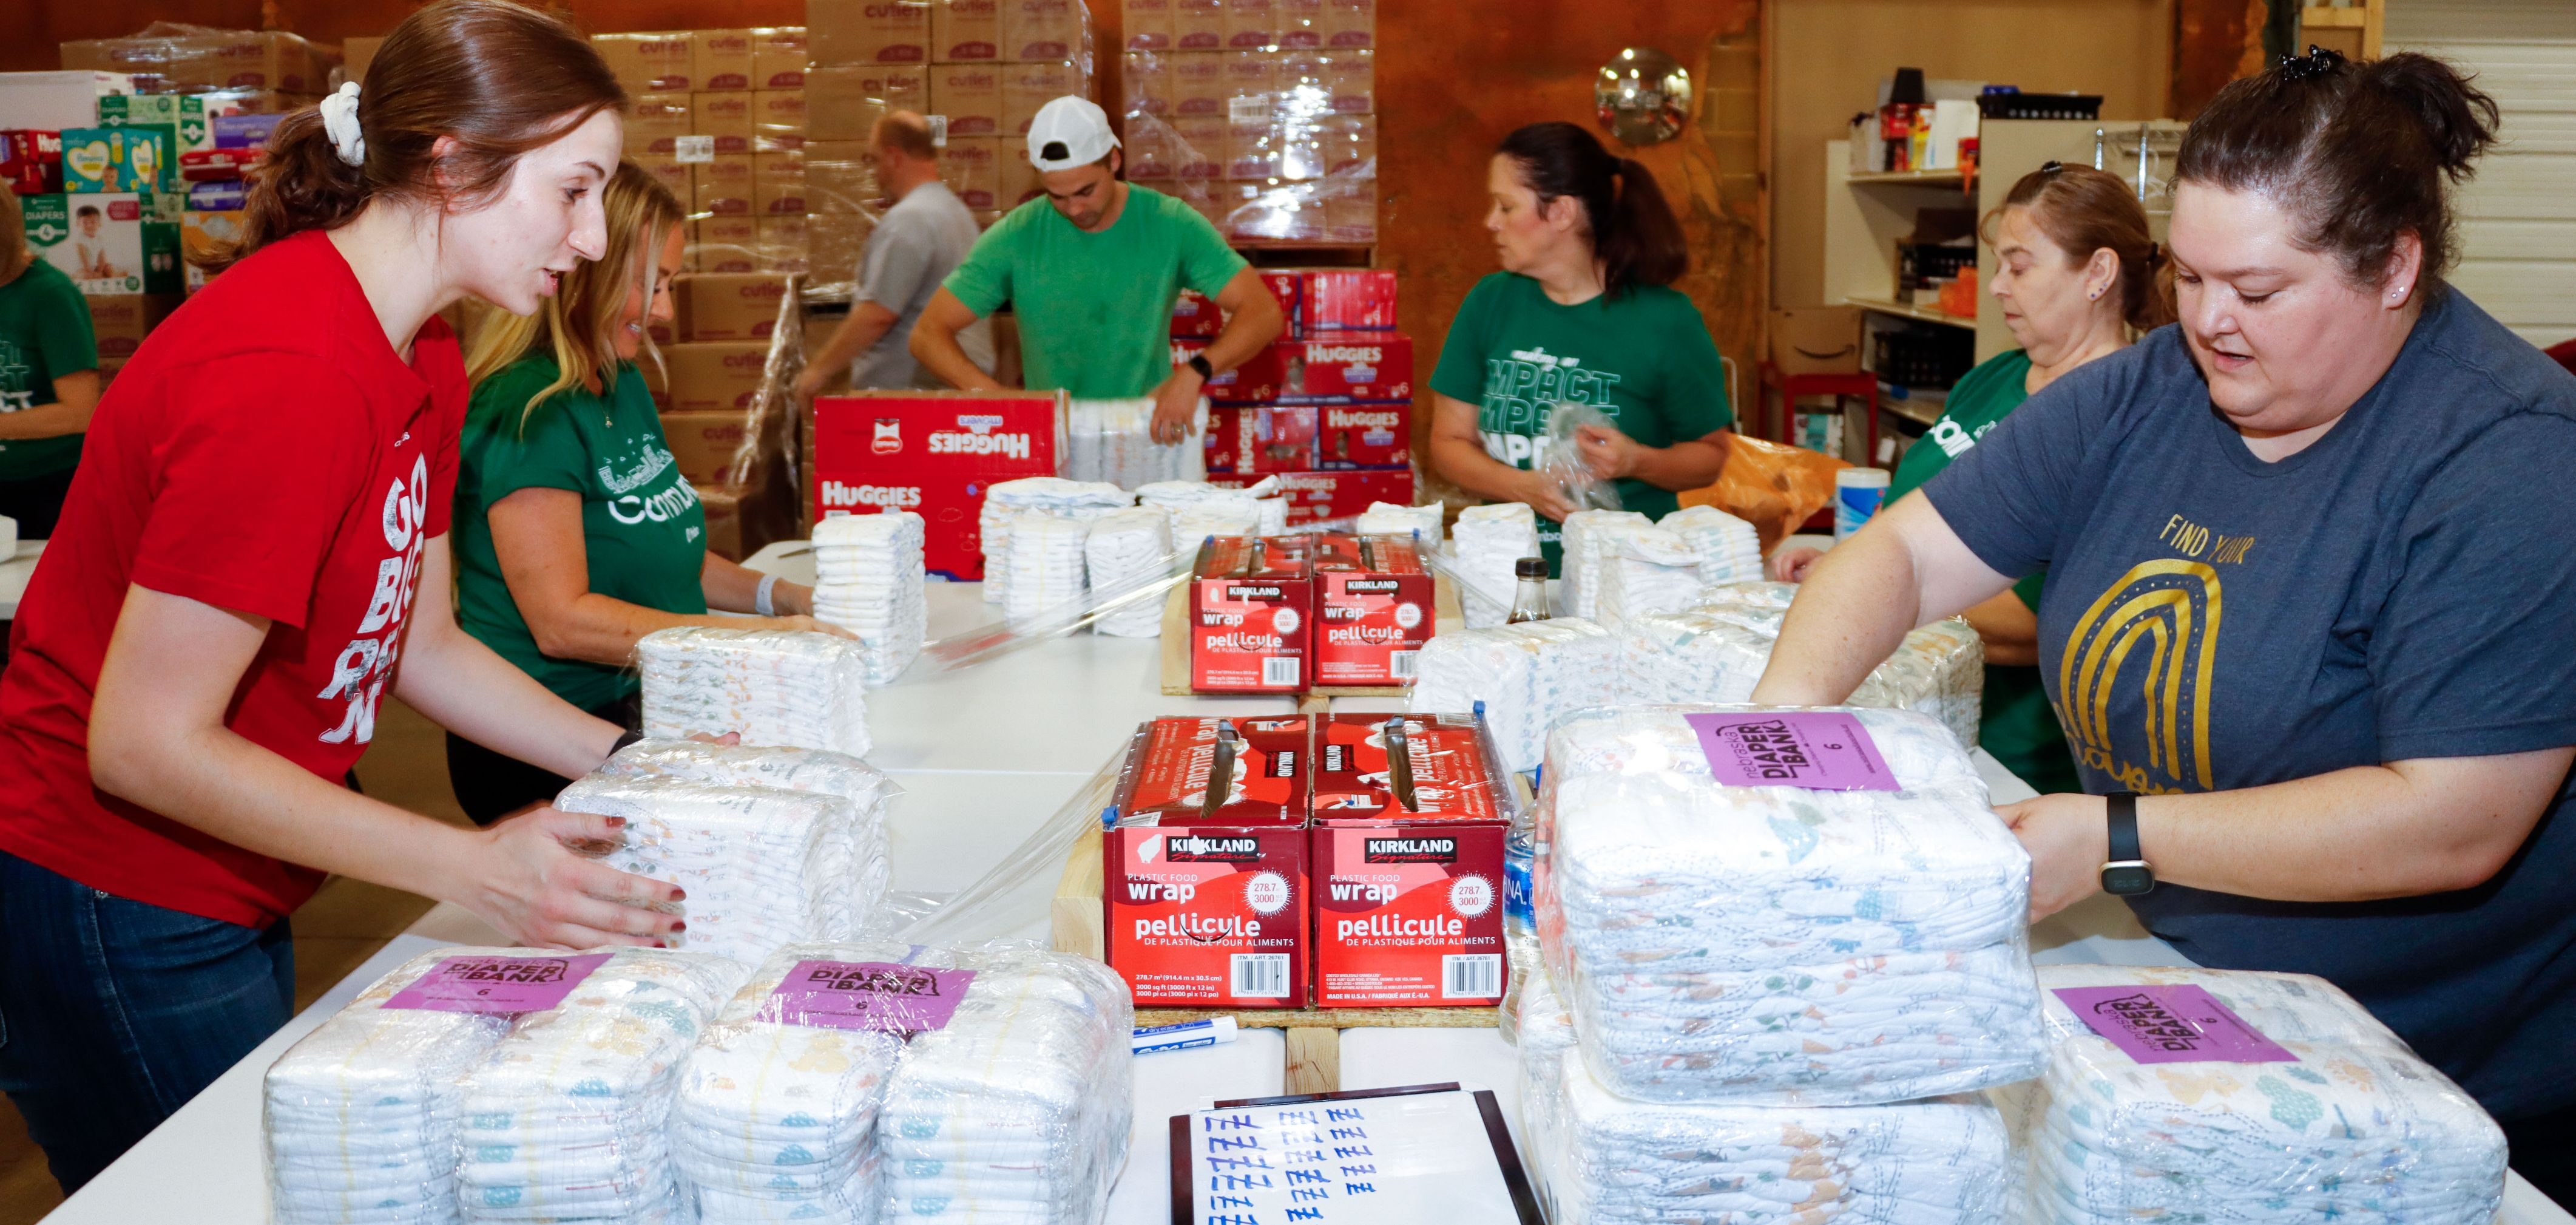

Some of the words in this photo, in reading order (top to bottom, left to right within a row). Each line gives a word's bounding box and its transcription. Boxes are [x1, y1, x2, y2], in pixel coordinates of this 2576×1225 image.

[25, 211, 65, 220] DIAPERS
[1307, 343, 1382, 362] HUGGIES
[1328, 409, 1399, 427] HUGGIES
[928, 433, 1030, 458] HUGGIES
[382, 452, 427, 551] GO
[822, 481, 921, 506] HUGGIES
[2160, 514, 2209, 557] FIND
[2208, 535, 2254, 564] YOUR
[1229, 587, 1280, 596] KIRKLAND
[1347, 580, 1399, 589] KIRKLAND
[1203, 614, 1243, 627] wrap
[1325, 608, 1365, 620] wrap
[1206, 632, 1282, 649] pellicule
[1329, 625, 1404, 642] pellicule
[1191, 718, 1220, 741] wrap
[1737, 725, 1790, 779] DIAPER
[1762, 724, 1810, 768] BANK
[1327, 745, 1341, 771] KIRKLAND
[1724, 731, 1760, 779] nebraska
[1277, 752, 1294, 777] KIRKLAND
[1369, 840, 1454, 853] KIRKLAND
[1370, 852, 1453, 863] Signature
[1128, 882, 1195, 904] wrap
[1254, 882, 1276, 892] 278.7
[1330, 883, 1398, 905] wrap
[1458, 886, 1479, 895] 278.7
[1254, 894, 1275, 903] 3000
[1458, 897, 1479, 906] 3000
[1135, 912, 1261, 940] pellicule
[1337, 914, 1463, 941] pellicule
[1160, 937, 1214, 947] PLASTIQUE
[1448, 937, 1496, 945] ALIMENTS
[448, 963, 561, 974] DIAPER
[465, 971, 553, 982] BANK
[809, 970, 930, 986] DIAPER
[834, 980, 926, 996] BANK
[2111, 1002, 2190, 1051] DIAPER
[2138, 997, 2201, 1040] BANK
